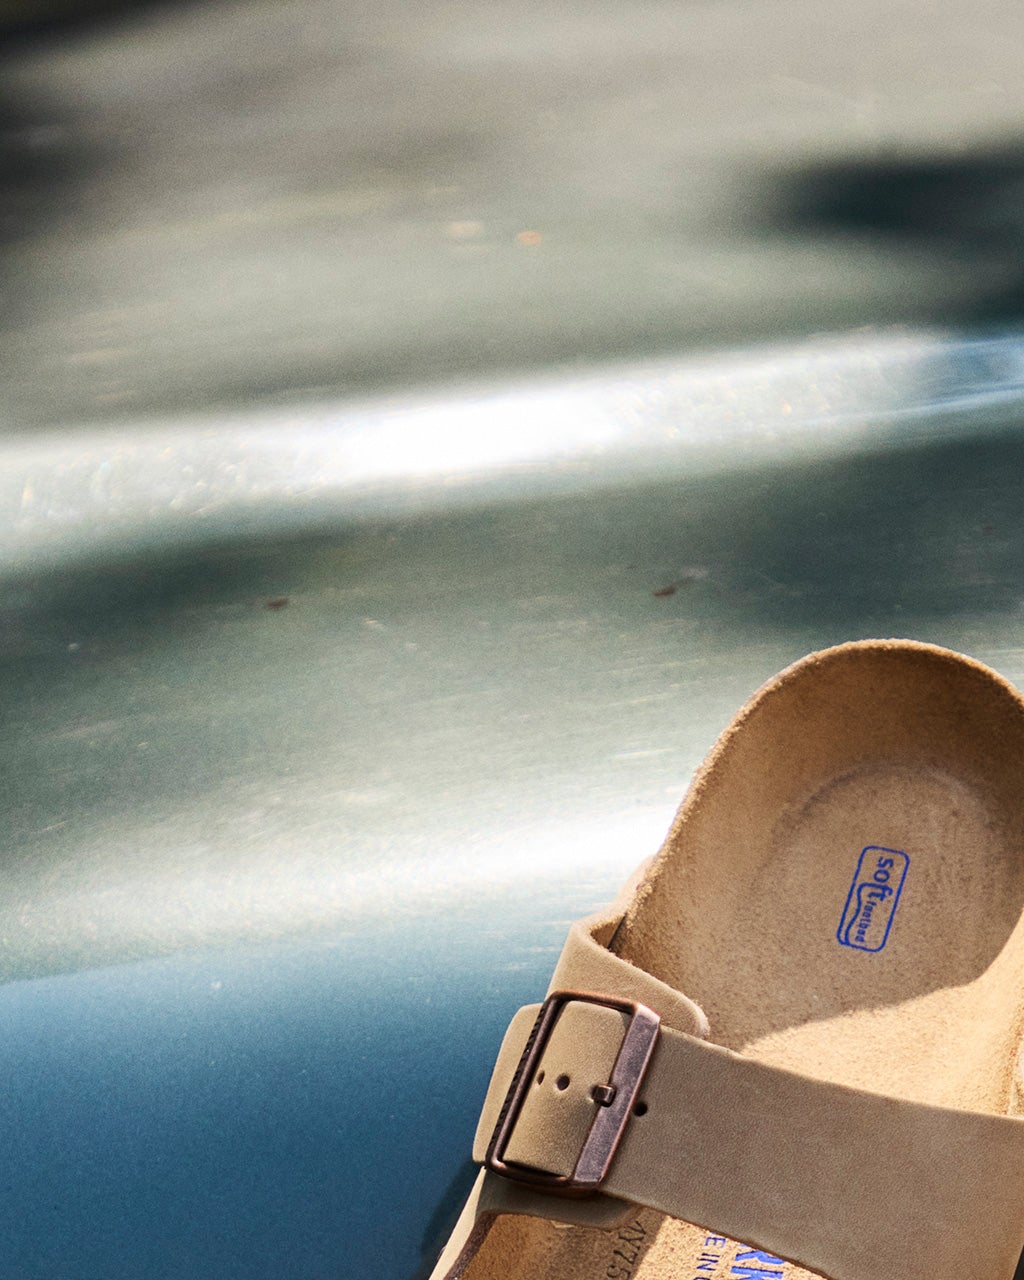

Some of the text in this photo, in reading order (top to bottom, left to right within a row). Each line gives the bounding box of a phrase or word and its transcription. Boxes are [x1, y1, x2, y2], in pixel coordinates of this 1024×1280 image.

[855, 856, 894, 943] soft footbed
[696, 1252, 720, 1271] IN
